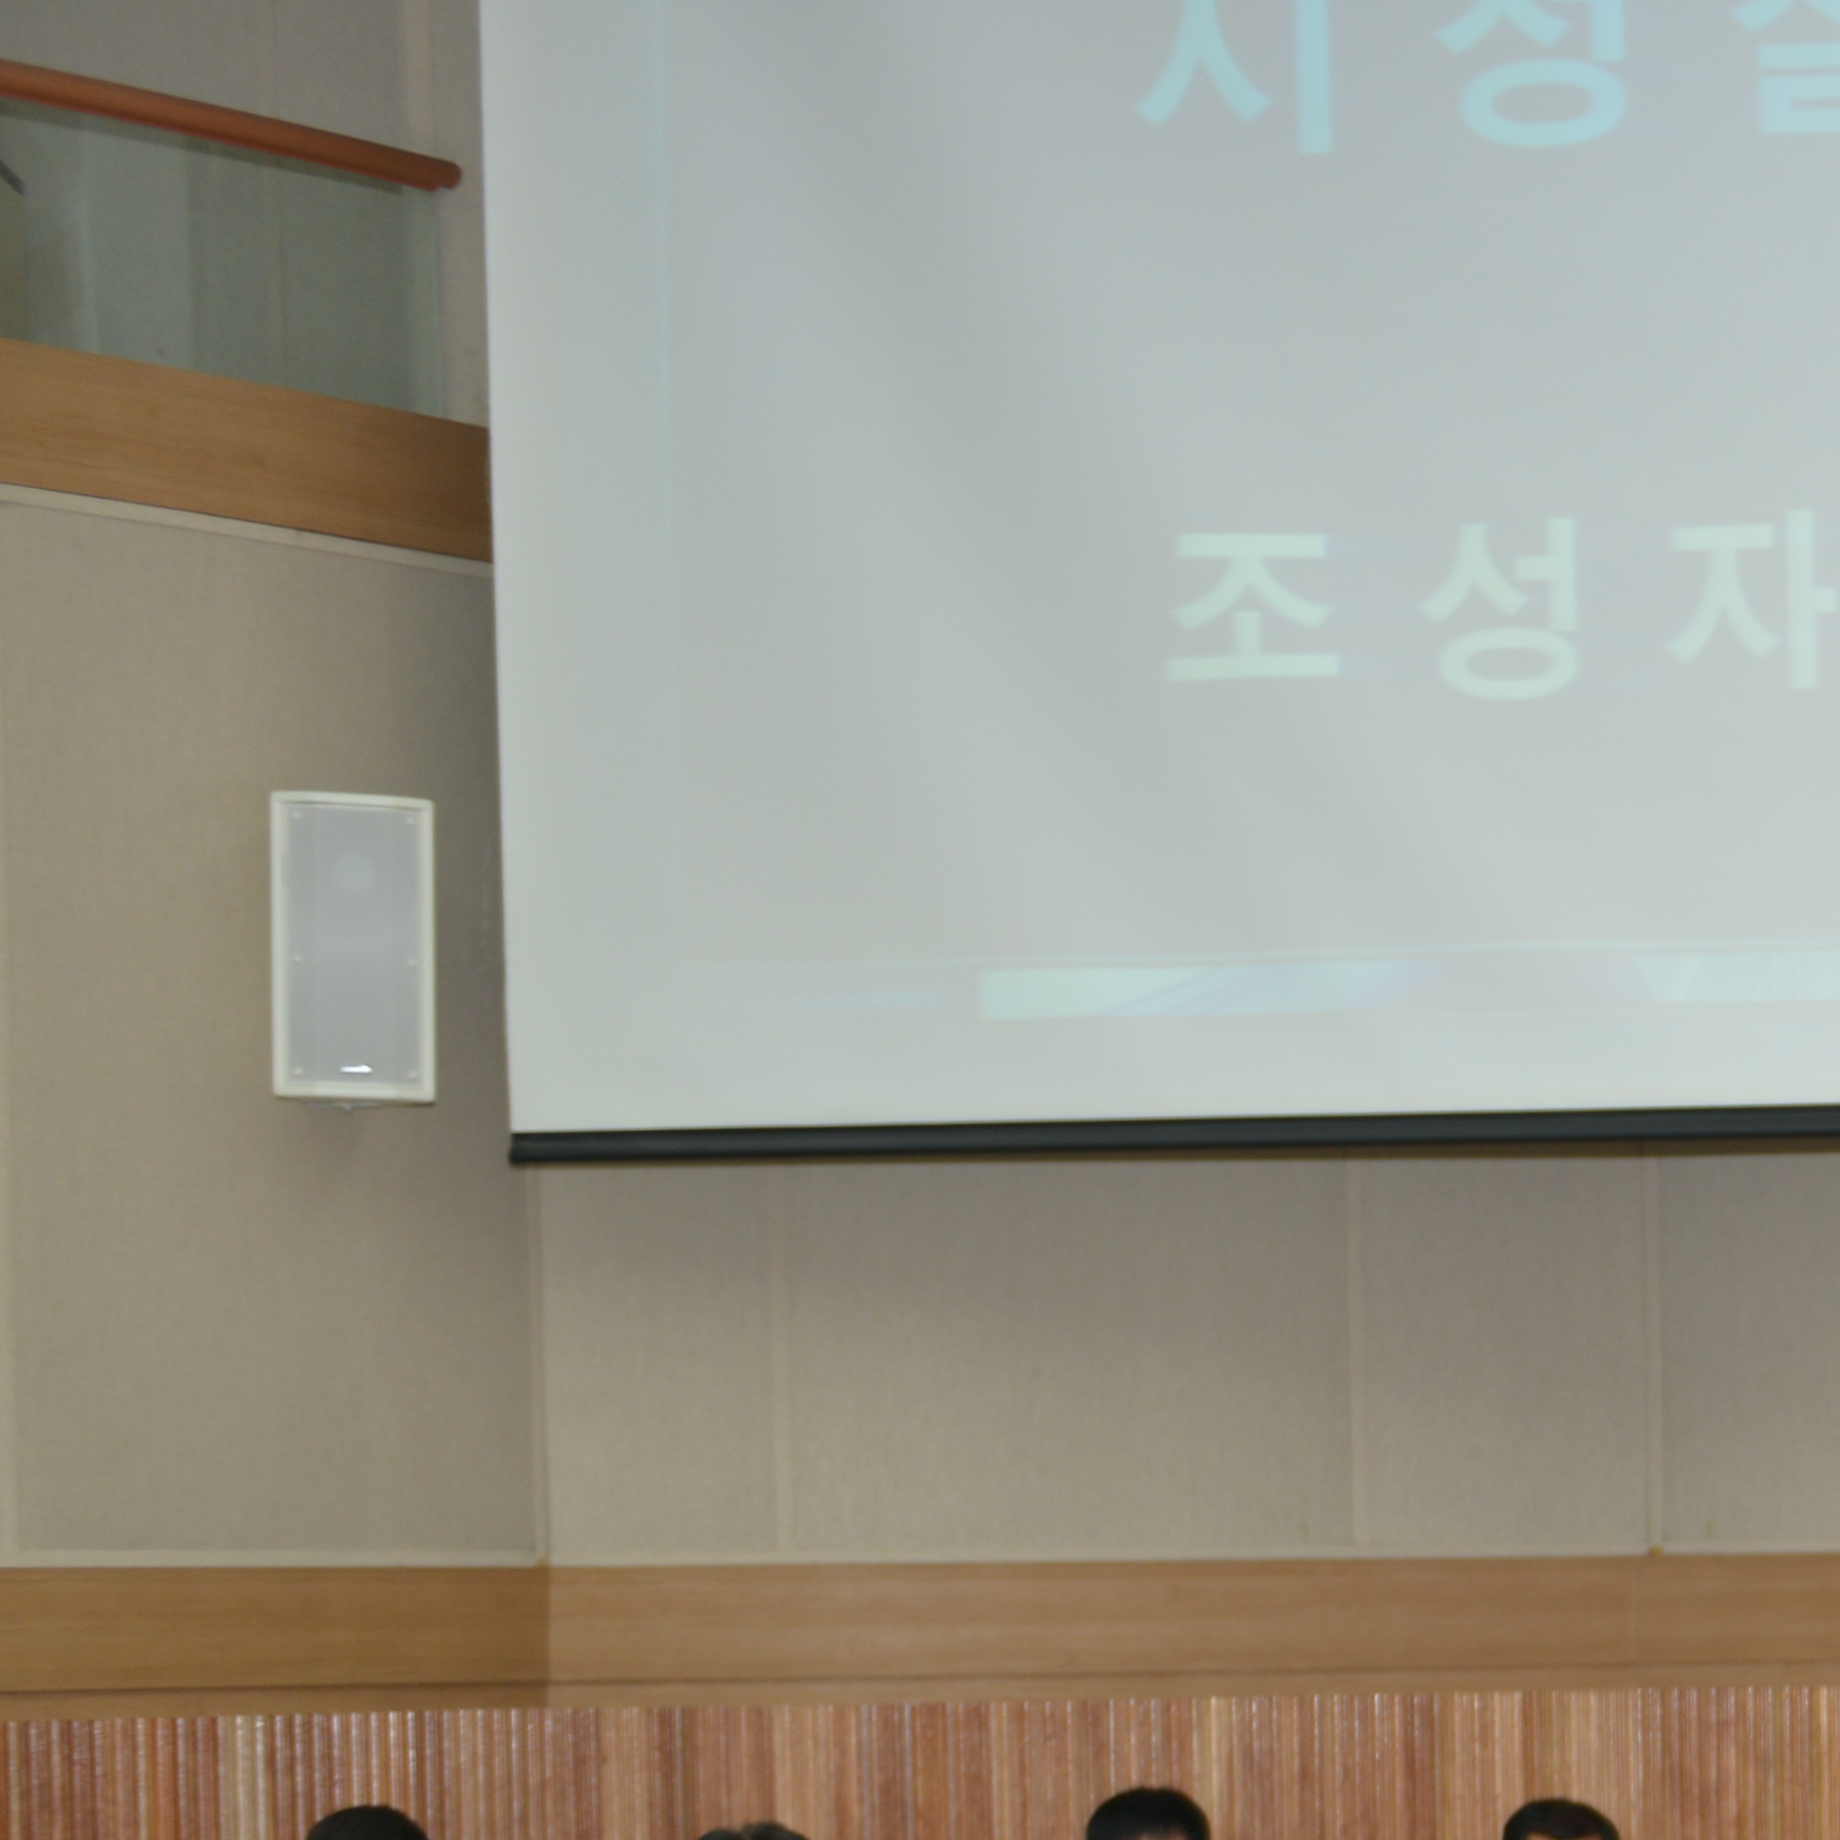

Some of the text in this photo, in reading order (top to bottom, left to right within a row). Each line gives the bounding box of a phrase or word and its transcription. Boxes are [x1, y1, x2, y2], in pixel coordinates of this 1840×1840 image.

[1166, 532, 1340, 682] 조
[1418, 515, 1579, 700] 성
[1666, 508, 1840, 690] 자
